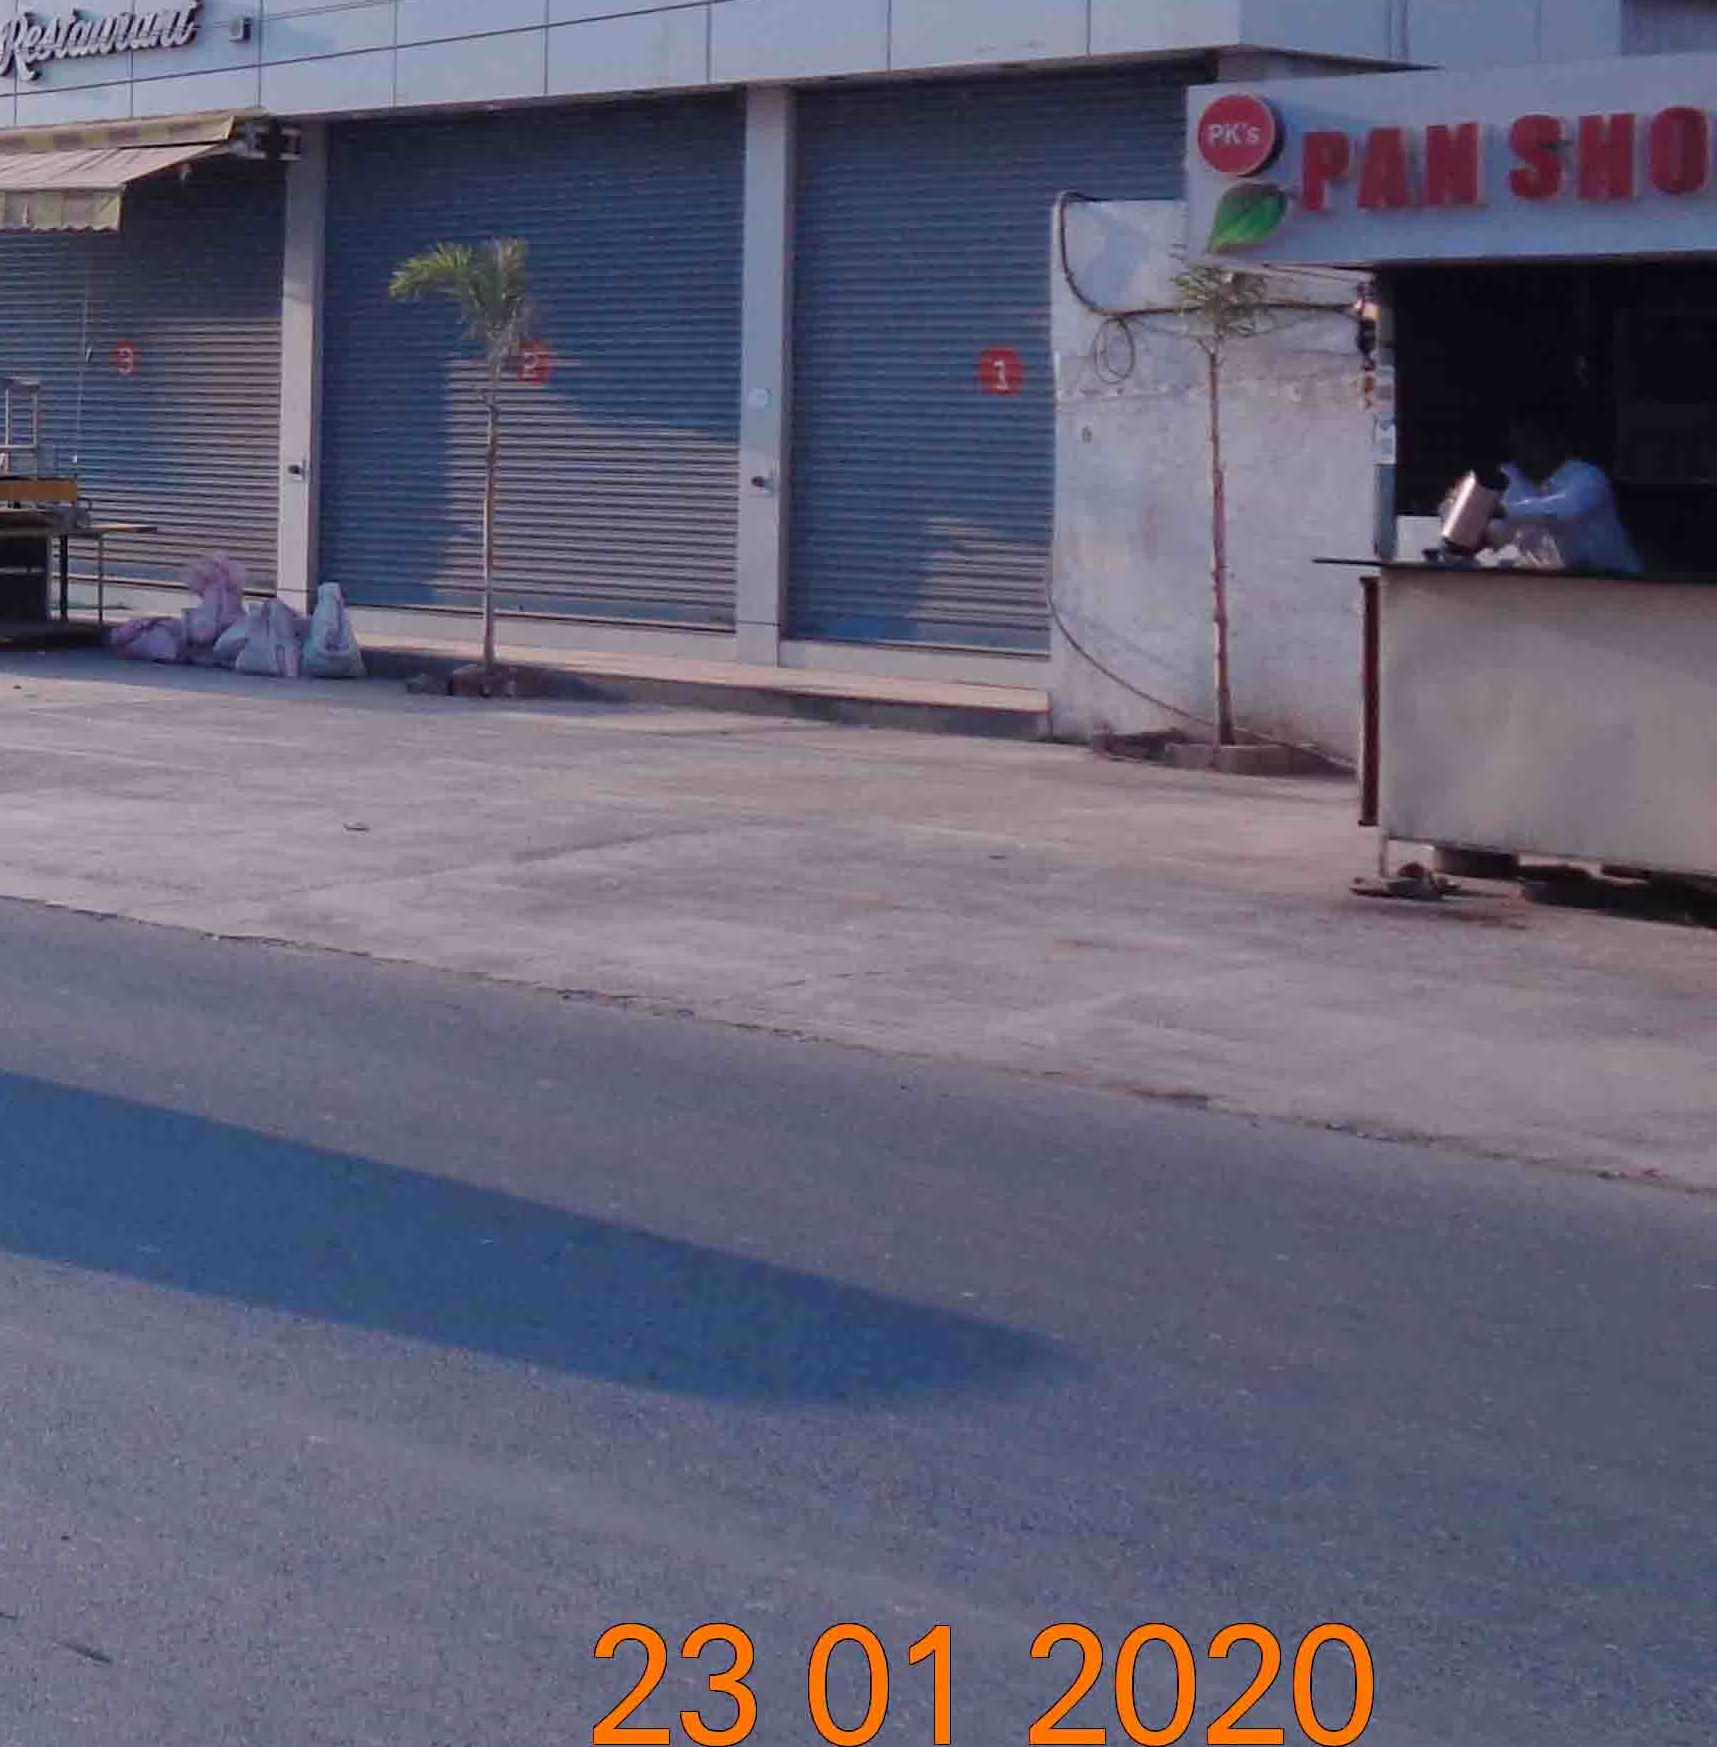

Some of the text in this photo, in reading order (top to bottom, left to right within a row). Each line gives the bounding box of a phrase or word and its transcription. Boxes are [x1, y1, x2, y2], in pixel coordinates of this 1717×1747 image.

[1300, 105, 1711, 212] PAN SHO
[116, 347, 135, 375] 3
